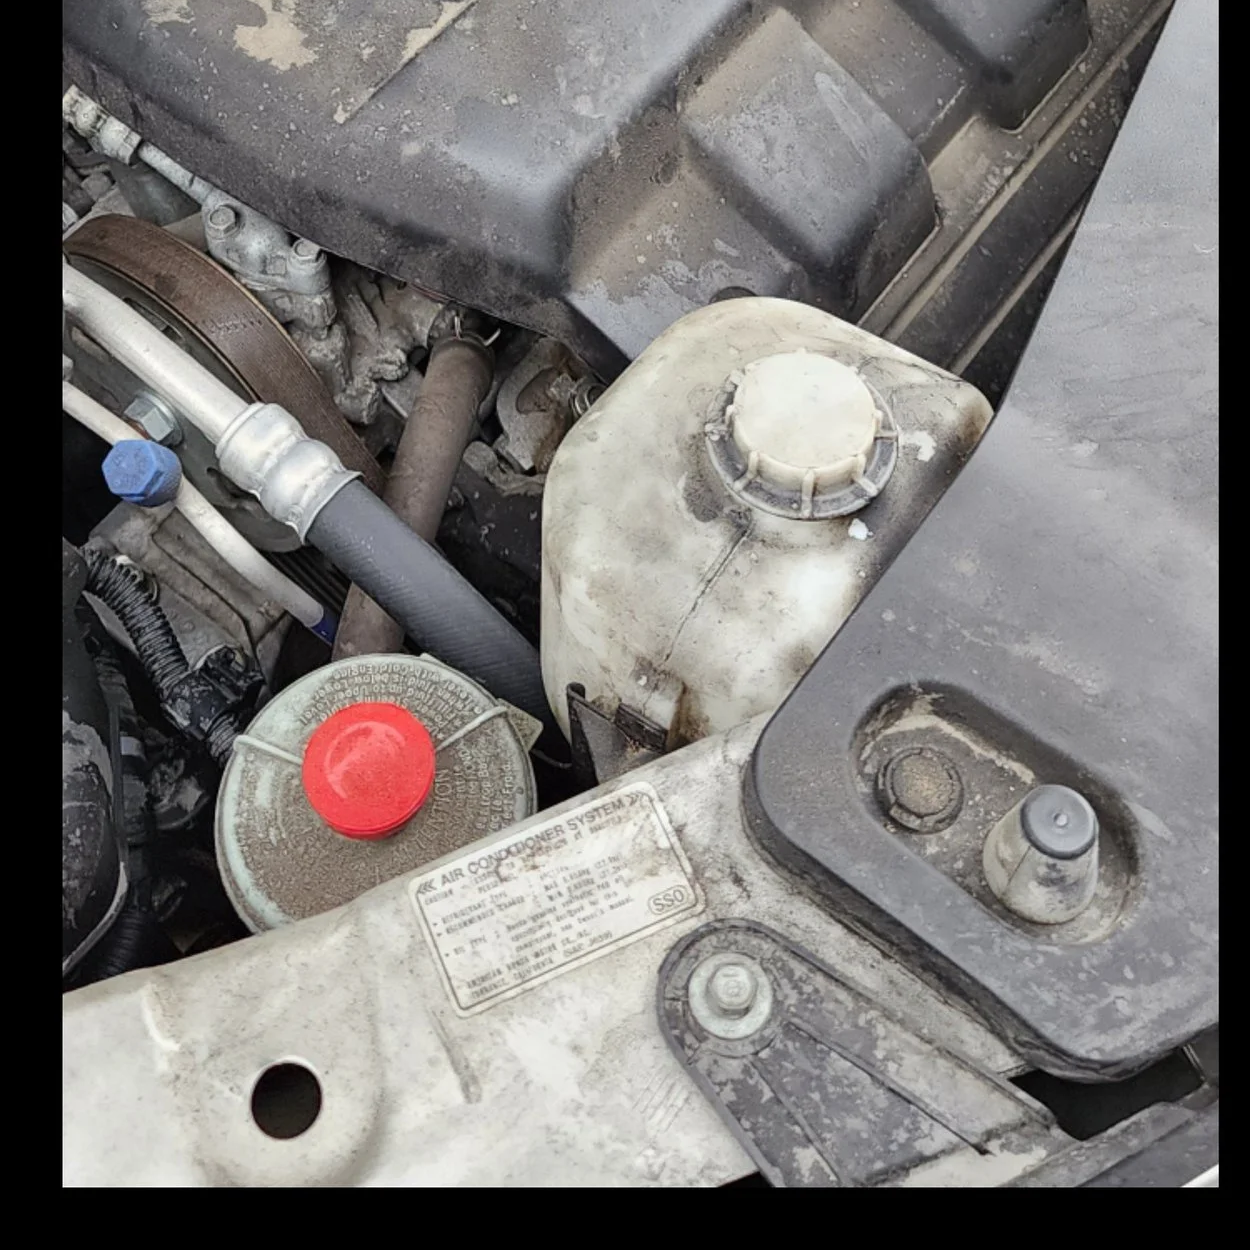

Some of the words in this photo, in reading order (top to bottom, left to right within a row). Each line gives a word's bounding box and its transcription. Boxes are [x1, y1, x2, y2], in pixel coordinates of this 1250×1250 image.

[437, 866, 466, 888] AIR
[465, 821, 566, 877] CONDITIONER
[565, 795, 626, 832] SYSTEM
